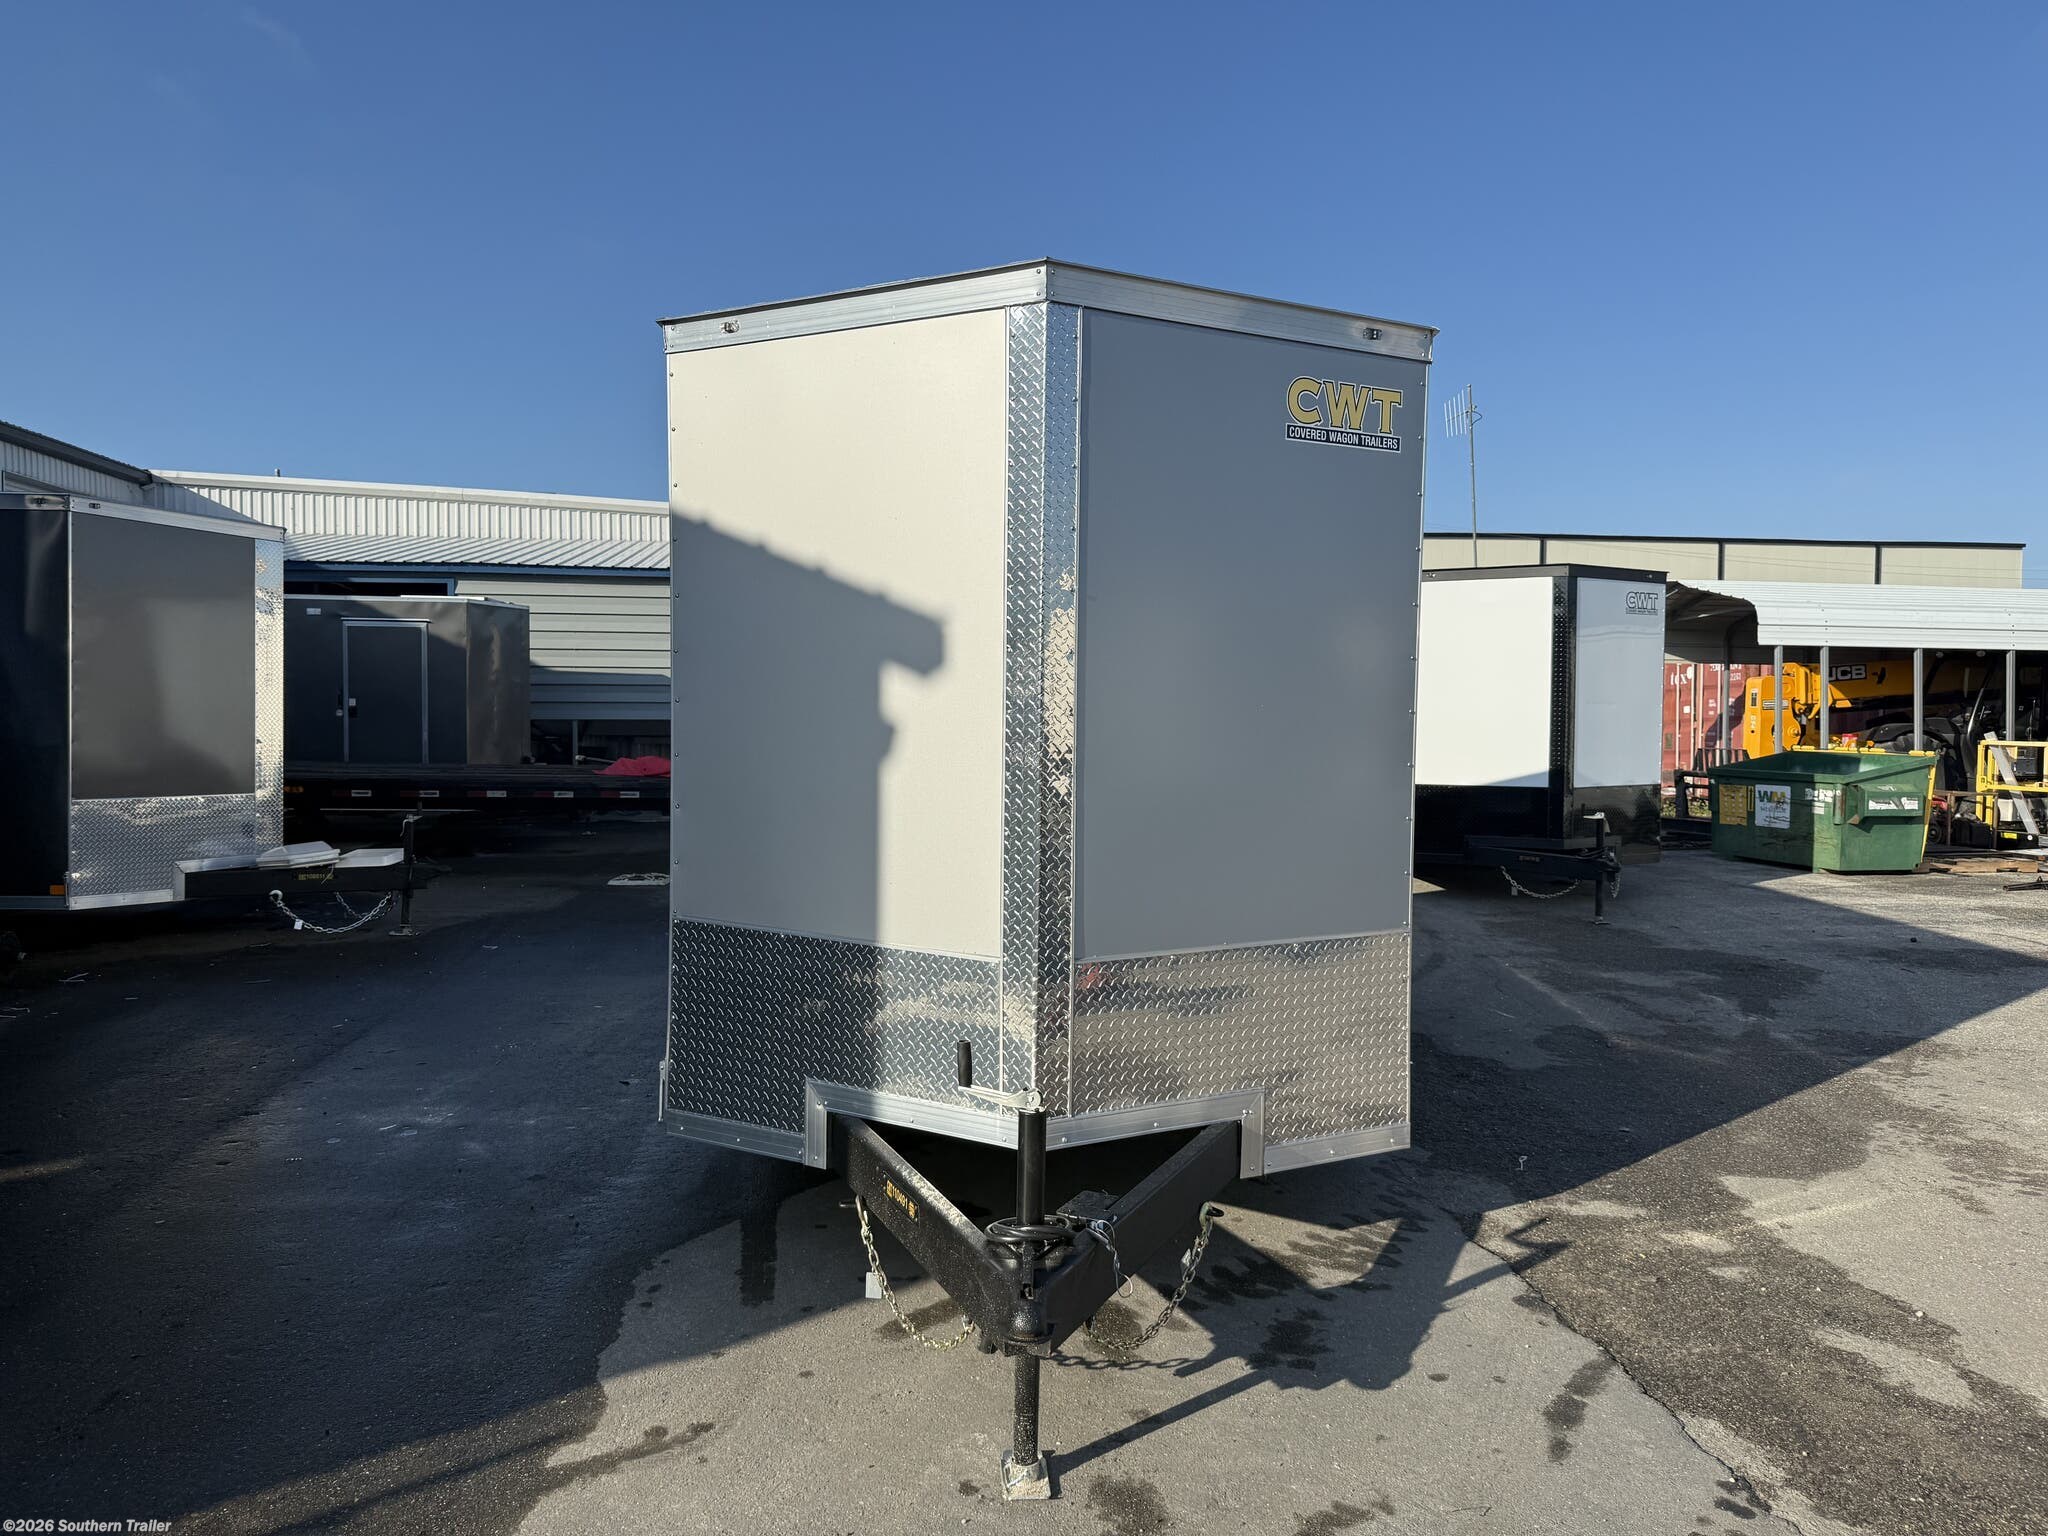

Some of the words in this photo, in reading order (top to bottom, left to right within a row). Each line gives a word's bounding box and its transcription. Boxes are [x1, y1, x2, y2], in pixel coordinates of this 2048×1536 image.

[1287, 376, 1403, 434] CWT
[1289, 426, 1327, 441] COVERED
[1329, 431, 1359, 445] WAGON
[1361, 435, 1398, 449] TRAILERS
[1626, 591, 1658, 610] CWT
